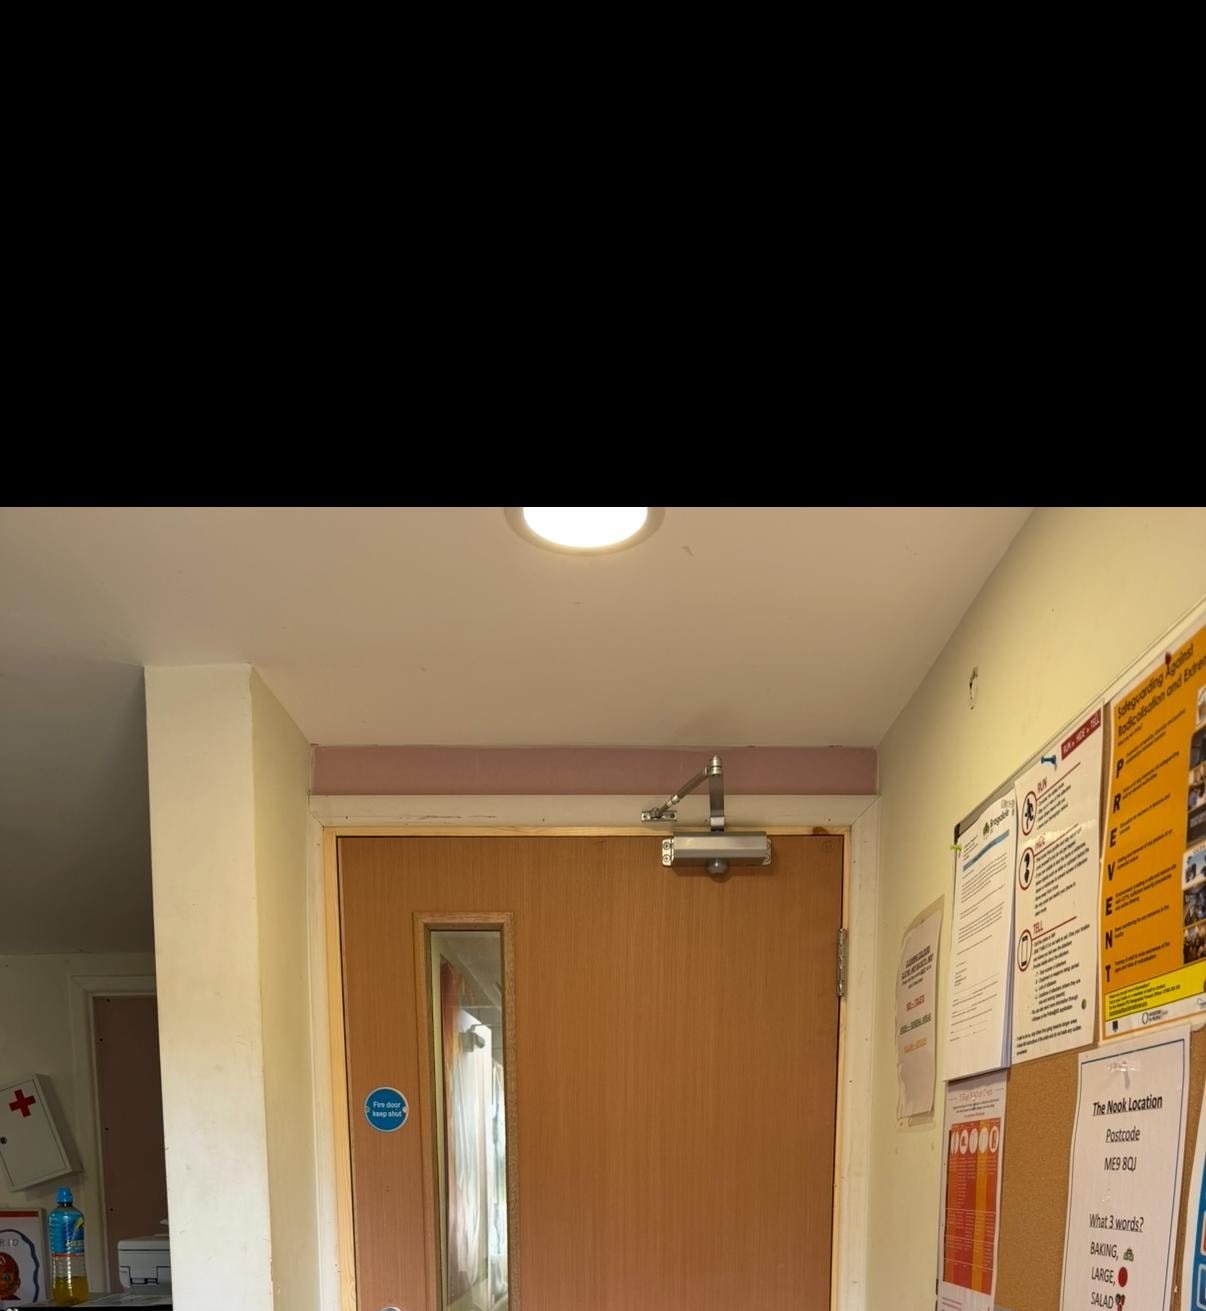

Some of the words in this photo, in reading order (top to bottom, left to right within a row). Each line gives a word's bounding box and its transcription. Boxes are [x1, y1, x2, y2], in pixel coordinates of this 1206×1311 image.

[1117, 674, 1164, 719] Safeguarding
[1165, 643, 1194, 679] Against
[1118, 692, 1165, 737] Radicalisation
[1166, 673, 1182, 696] and
[1036, 777, 1047, 792] RUN
[1033, 920, 1044, 934] TELL
[372, 1101, 386, 1109] Fire
[386, 1101, 401, 1109] door
[1092, 1102, 1106, 1115] The
[1107, 1097, 1127, 1114] Nook
[1128, 1094, 1163, 1112] Location
[371, 1110, 388, 1119] keep
[388, 1110, 402, 1118] shut
[1106, 1126, 1140, 1143] Postcode
[1104, 1156, 1121, 1171] ME9
[1122, 1155, 1137, 1172] 8QJ
[1089, 1213, 1108, 1228] What
[1109, 1216, 1114, 1229] 3
[1115, 1216, 1144, 1232] words?
[1090, 1241, 1119, 1261] BAKING,
[1091, 1266, 1116, 1286] LARGE,
[1090, 1291, 1114, 1309] SALAD
